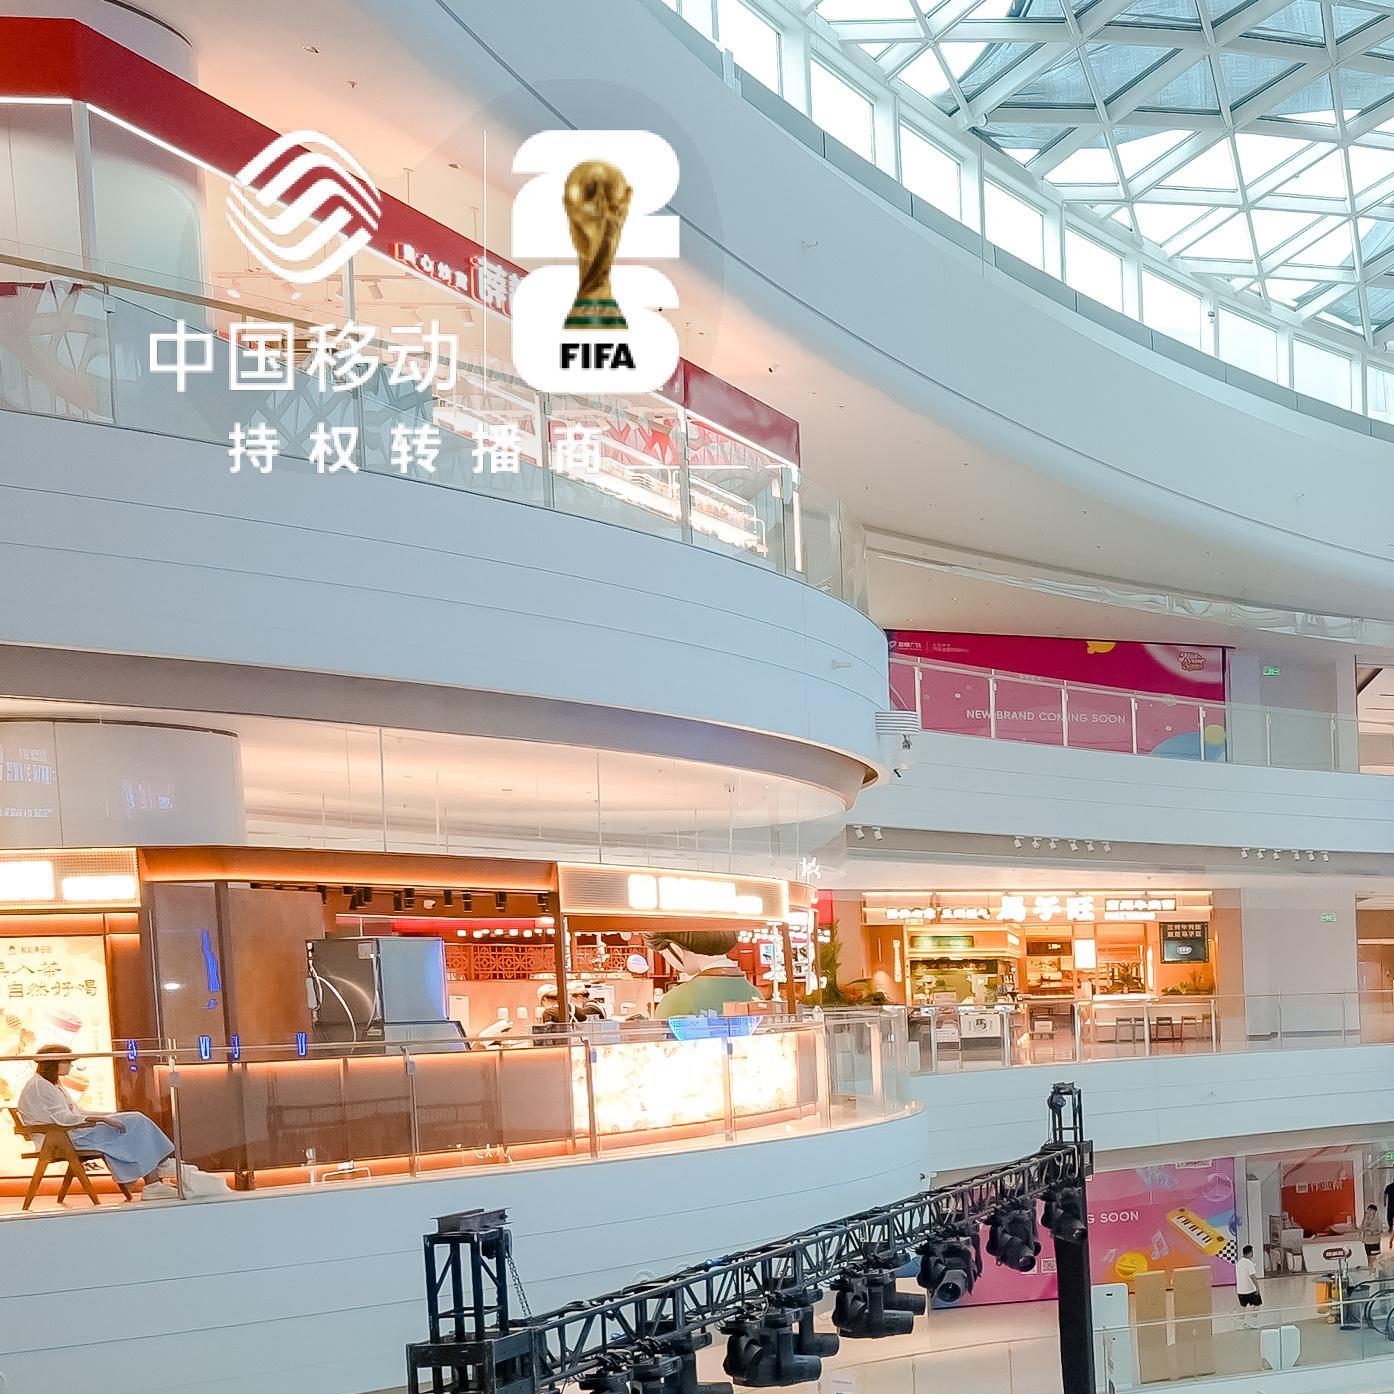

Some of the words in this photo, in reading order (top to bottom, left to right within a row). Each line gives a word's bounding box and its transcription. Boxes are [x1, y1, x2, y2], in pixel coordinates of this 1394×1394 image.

[966, 708, 991, 722] NEW
[996, 710, 1036, 723] BRAND
[1092, 713, 1127, 726] SOON
[7, 979, 98, 998] 自然好喝
[1100, 1210, 1140, 1224] SOON
